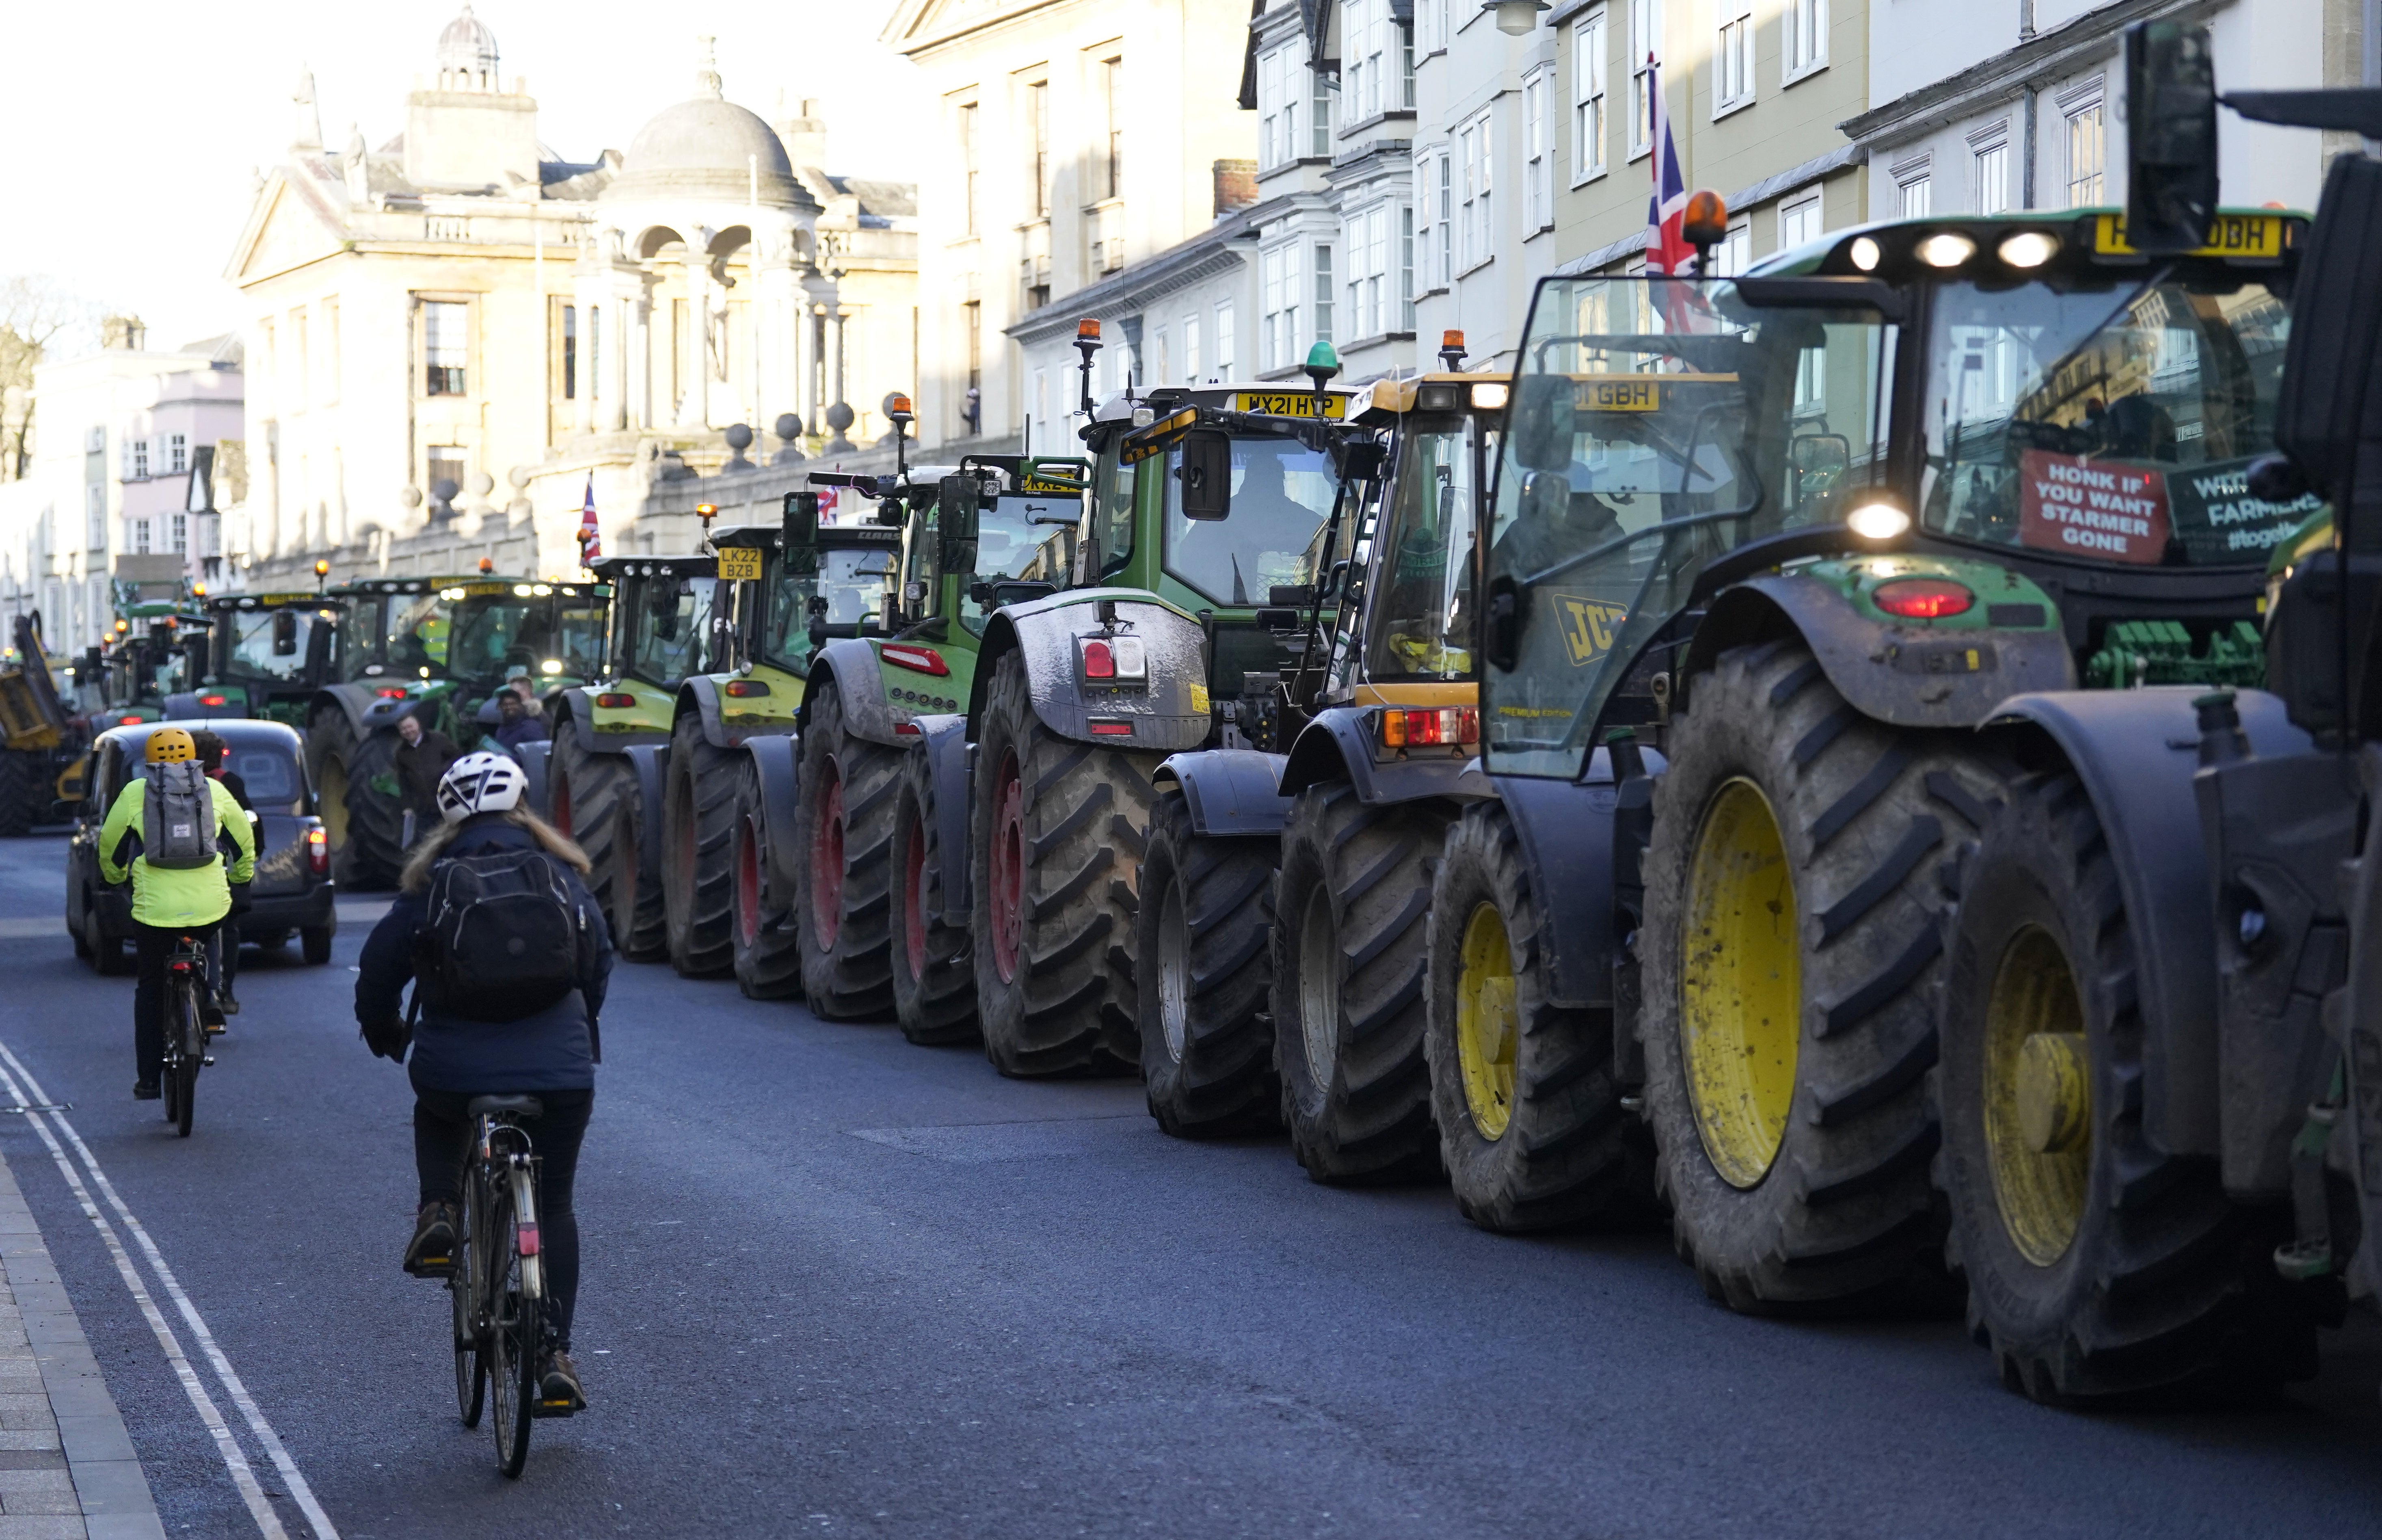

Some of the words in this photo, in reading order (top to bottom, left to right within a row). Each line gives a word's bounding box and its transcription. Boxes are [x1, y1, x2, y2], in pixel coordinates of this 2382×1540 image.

[1598, 383, 1649, 405] GBH
[1249, 396, 1290, 414] WX21
[2049, 464, 2115, 490] HONK
[2121, 476, 2142, 495] IF
[2035, 480, 2083, 505] YOU
[2089, 490, 2157, 517] WANT
[2041, 503, 2149, 537] STARMER
[857, 531, 901, 541] CLAAS
[2062, 527, 2127, 554] GONE
[722, 549, 758, 562] LK22
[727, 564, 753, 577] BZB
[1499, 706, 1540, 718] PREMIUM
